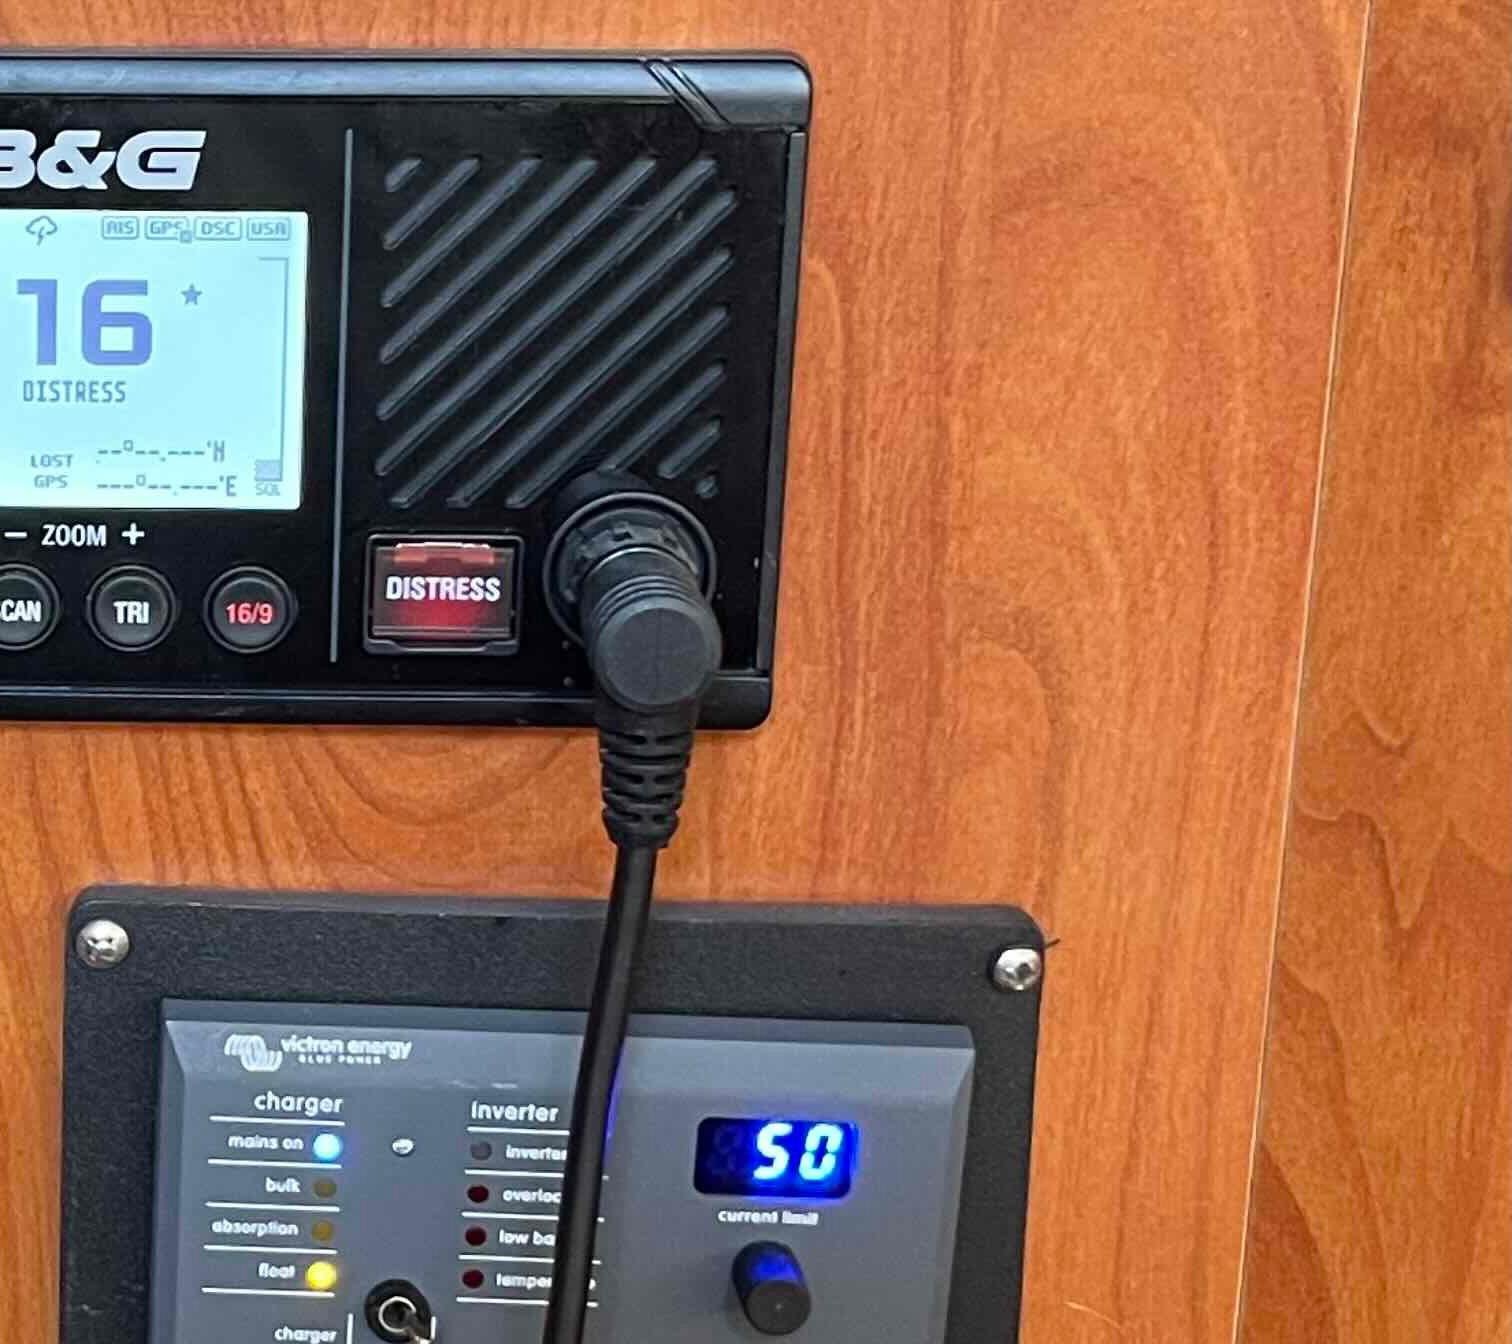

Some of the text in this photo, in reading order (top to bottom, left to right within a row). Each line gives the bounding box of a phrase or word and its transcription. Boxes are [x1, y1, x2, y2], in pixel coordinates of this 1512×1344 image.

[106, 221, 134, 235] AIS
[201, 221, 236, 235] DSC
[251, 222, 286, 235] USA
[16, 279, 153, 366] 16
[23, 380, 126, 403] DISTRESS
[31, 455, 73, 469] LOST
[34, 475, 67, 489] GPS
[42, 524, 107, 547] ZOOM
[386, 577, 500, 601] DISTRESS
[114, 602, 148, 624] TRI
[225, 602, 272, 625] 16/9
[281, 1035, 412, 1060] victron energy
[254, 1091, 343, 1116] charger
[471, 1101, 558, 1122] inverter
[228, 1135, 304, 1150] mains on
[754, 1123, 844, 1180] 50
[265, 1177, 300, 1192] bulk
[718, 1209, 818, 1225] current limit
[212, 1218, 298, 1237] absorption
[499, 1229, 529, 1244] low
[258, 1262, 295, 1278] float
[275, 1326, 336, 1344] charger
